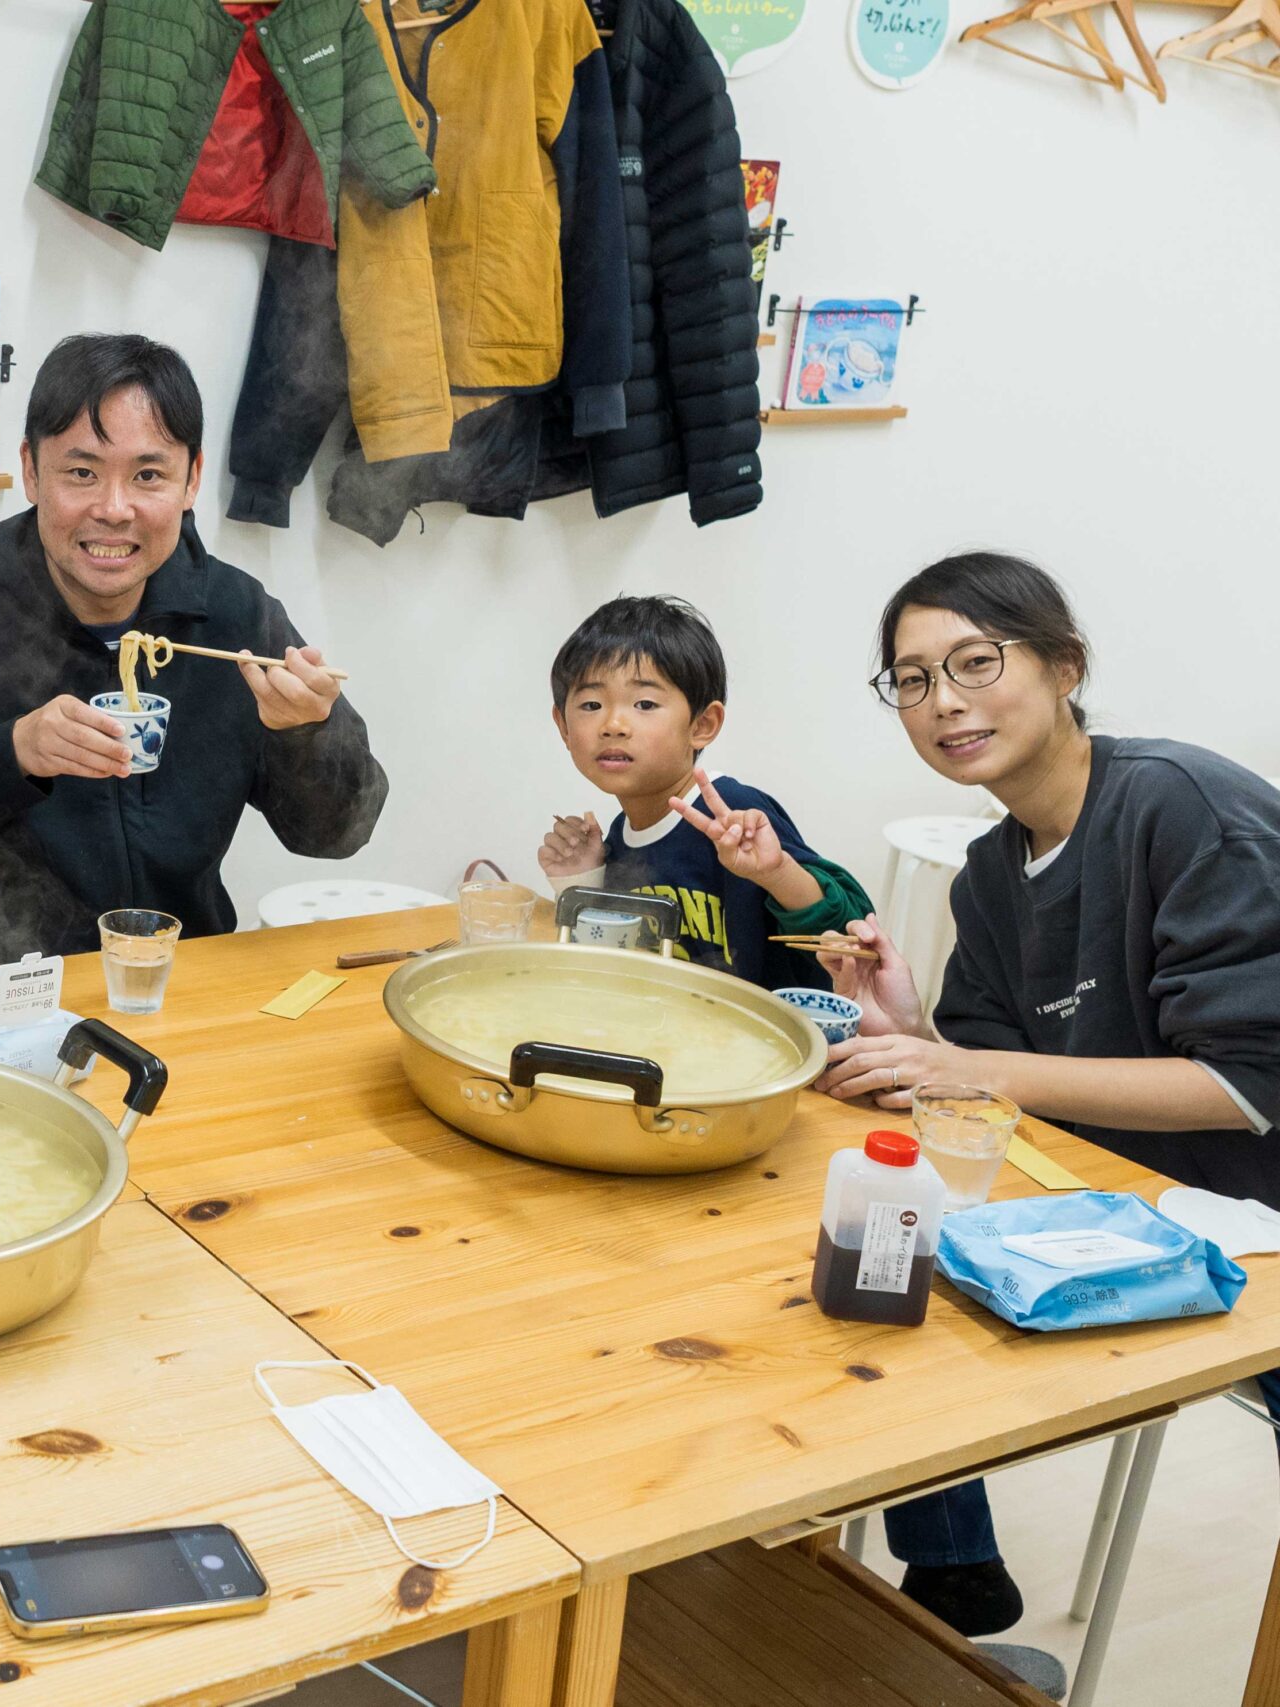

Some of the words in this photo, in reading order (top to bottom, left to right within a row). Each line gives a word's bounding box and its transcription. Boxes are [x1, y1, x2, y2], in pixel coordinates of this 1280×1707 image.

[6, 986, 34, 999] TISSUE
[37, 981, 55, 994] WET
[1002, 1276, 1020, 1295] 100
